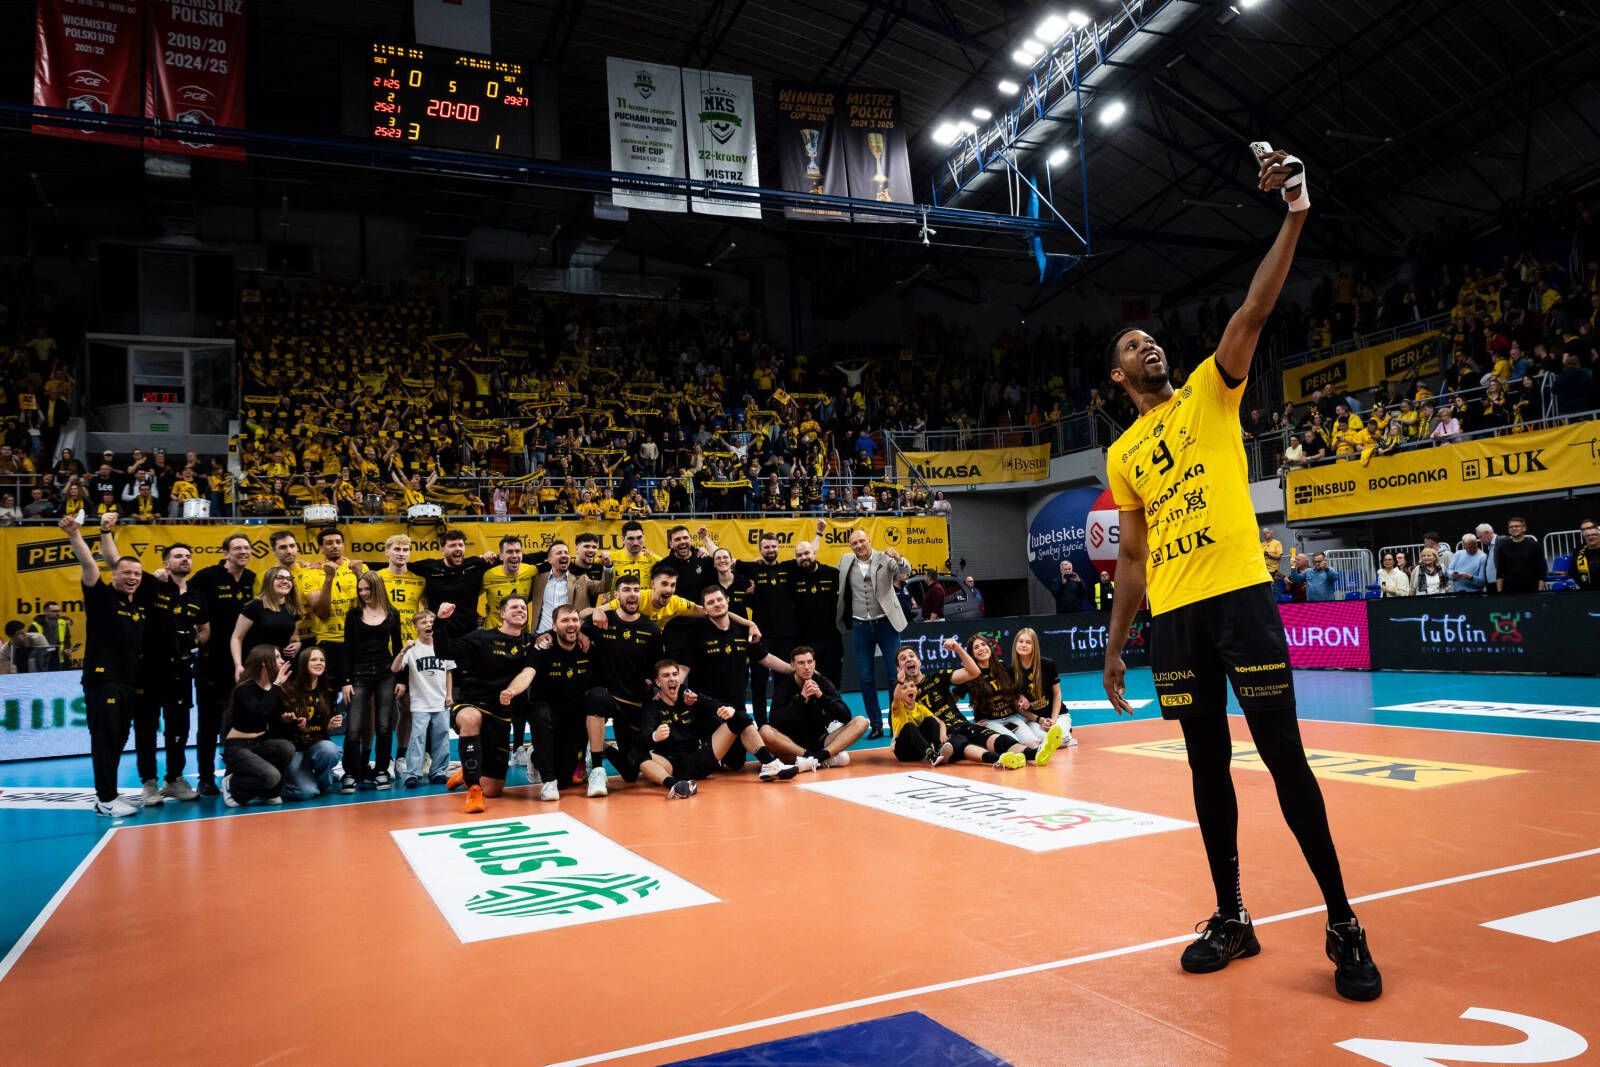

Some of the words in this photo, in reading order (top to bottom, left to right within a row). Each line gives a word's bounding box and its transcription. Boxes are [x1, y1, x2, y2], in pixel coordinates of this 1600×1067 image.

[62, 13, 118, 33] WICEMISTRZ
[171, 5, 224, 28] POLSKI
[65, 27, 97, 41] POLSKI
[167, 32, 227, 54] 2019/20
[165, 51, 229, 74] 2024/25
[373, 56, 387, 64] SET
[409, 70, 422, 87] 0
[503, 75, 517, 83] SET
[387, 92, 395, 102] 2
[486, 81, 499, 98] 0
[778, 88, 836, 106] WINNER
[704, 96, 736, 113] MKS
[846, 91, 896, 106] MISTRZ
[427, 99, 480, 122] 20:00
[614, 111, 650, 123] PUCHARU
[651, 116, 677, 127] POLSKI
[849, 105, 894, 119] POLSKI
[388, 117, 396, 127] 3
[408, 122, 420, 140] 3
[632, 145, 647, 153] EHF
[648, 147, 664, 156] CUP
[705, 169, 743, 180] MISTRZ
[1391, 347, 1431, 371] PERŁ
[1152, 440, 1174, 476] 9
[1485, 449, 1548, 478] LUK
[1368, 468, 1448, 490] BOGDANKA
[1313, 480, 1356, 496] INSBUD
[906, 527, 926, 535] BMW
[1032, 526, 1085, 548] lubelskie
[1109, 526, 1120, 544] S
[351, 541, 440, 553] BOGNKA
[598, 534, 626, 550] LU
[1165, 526, 1216, 561] LUK
[28, 540, 102, 565] PERA
[390, 589, 405, 602] 15
[17, 598, 83, 614] bim
[1284, 626, 1360, 646] URON
[1390, 614, 1487, 642] lublin
[1043, 625, 1109, 650] lubli
[415, 656, 447, 672] NIKE
[1234, 662, 1286, 673] BOMBARDINO
[417, 821, 578, 876] plus
